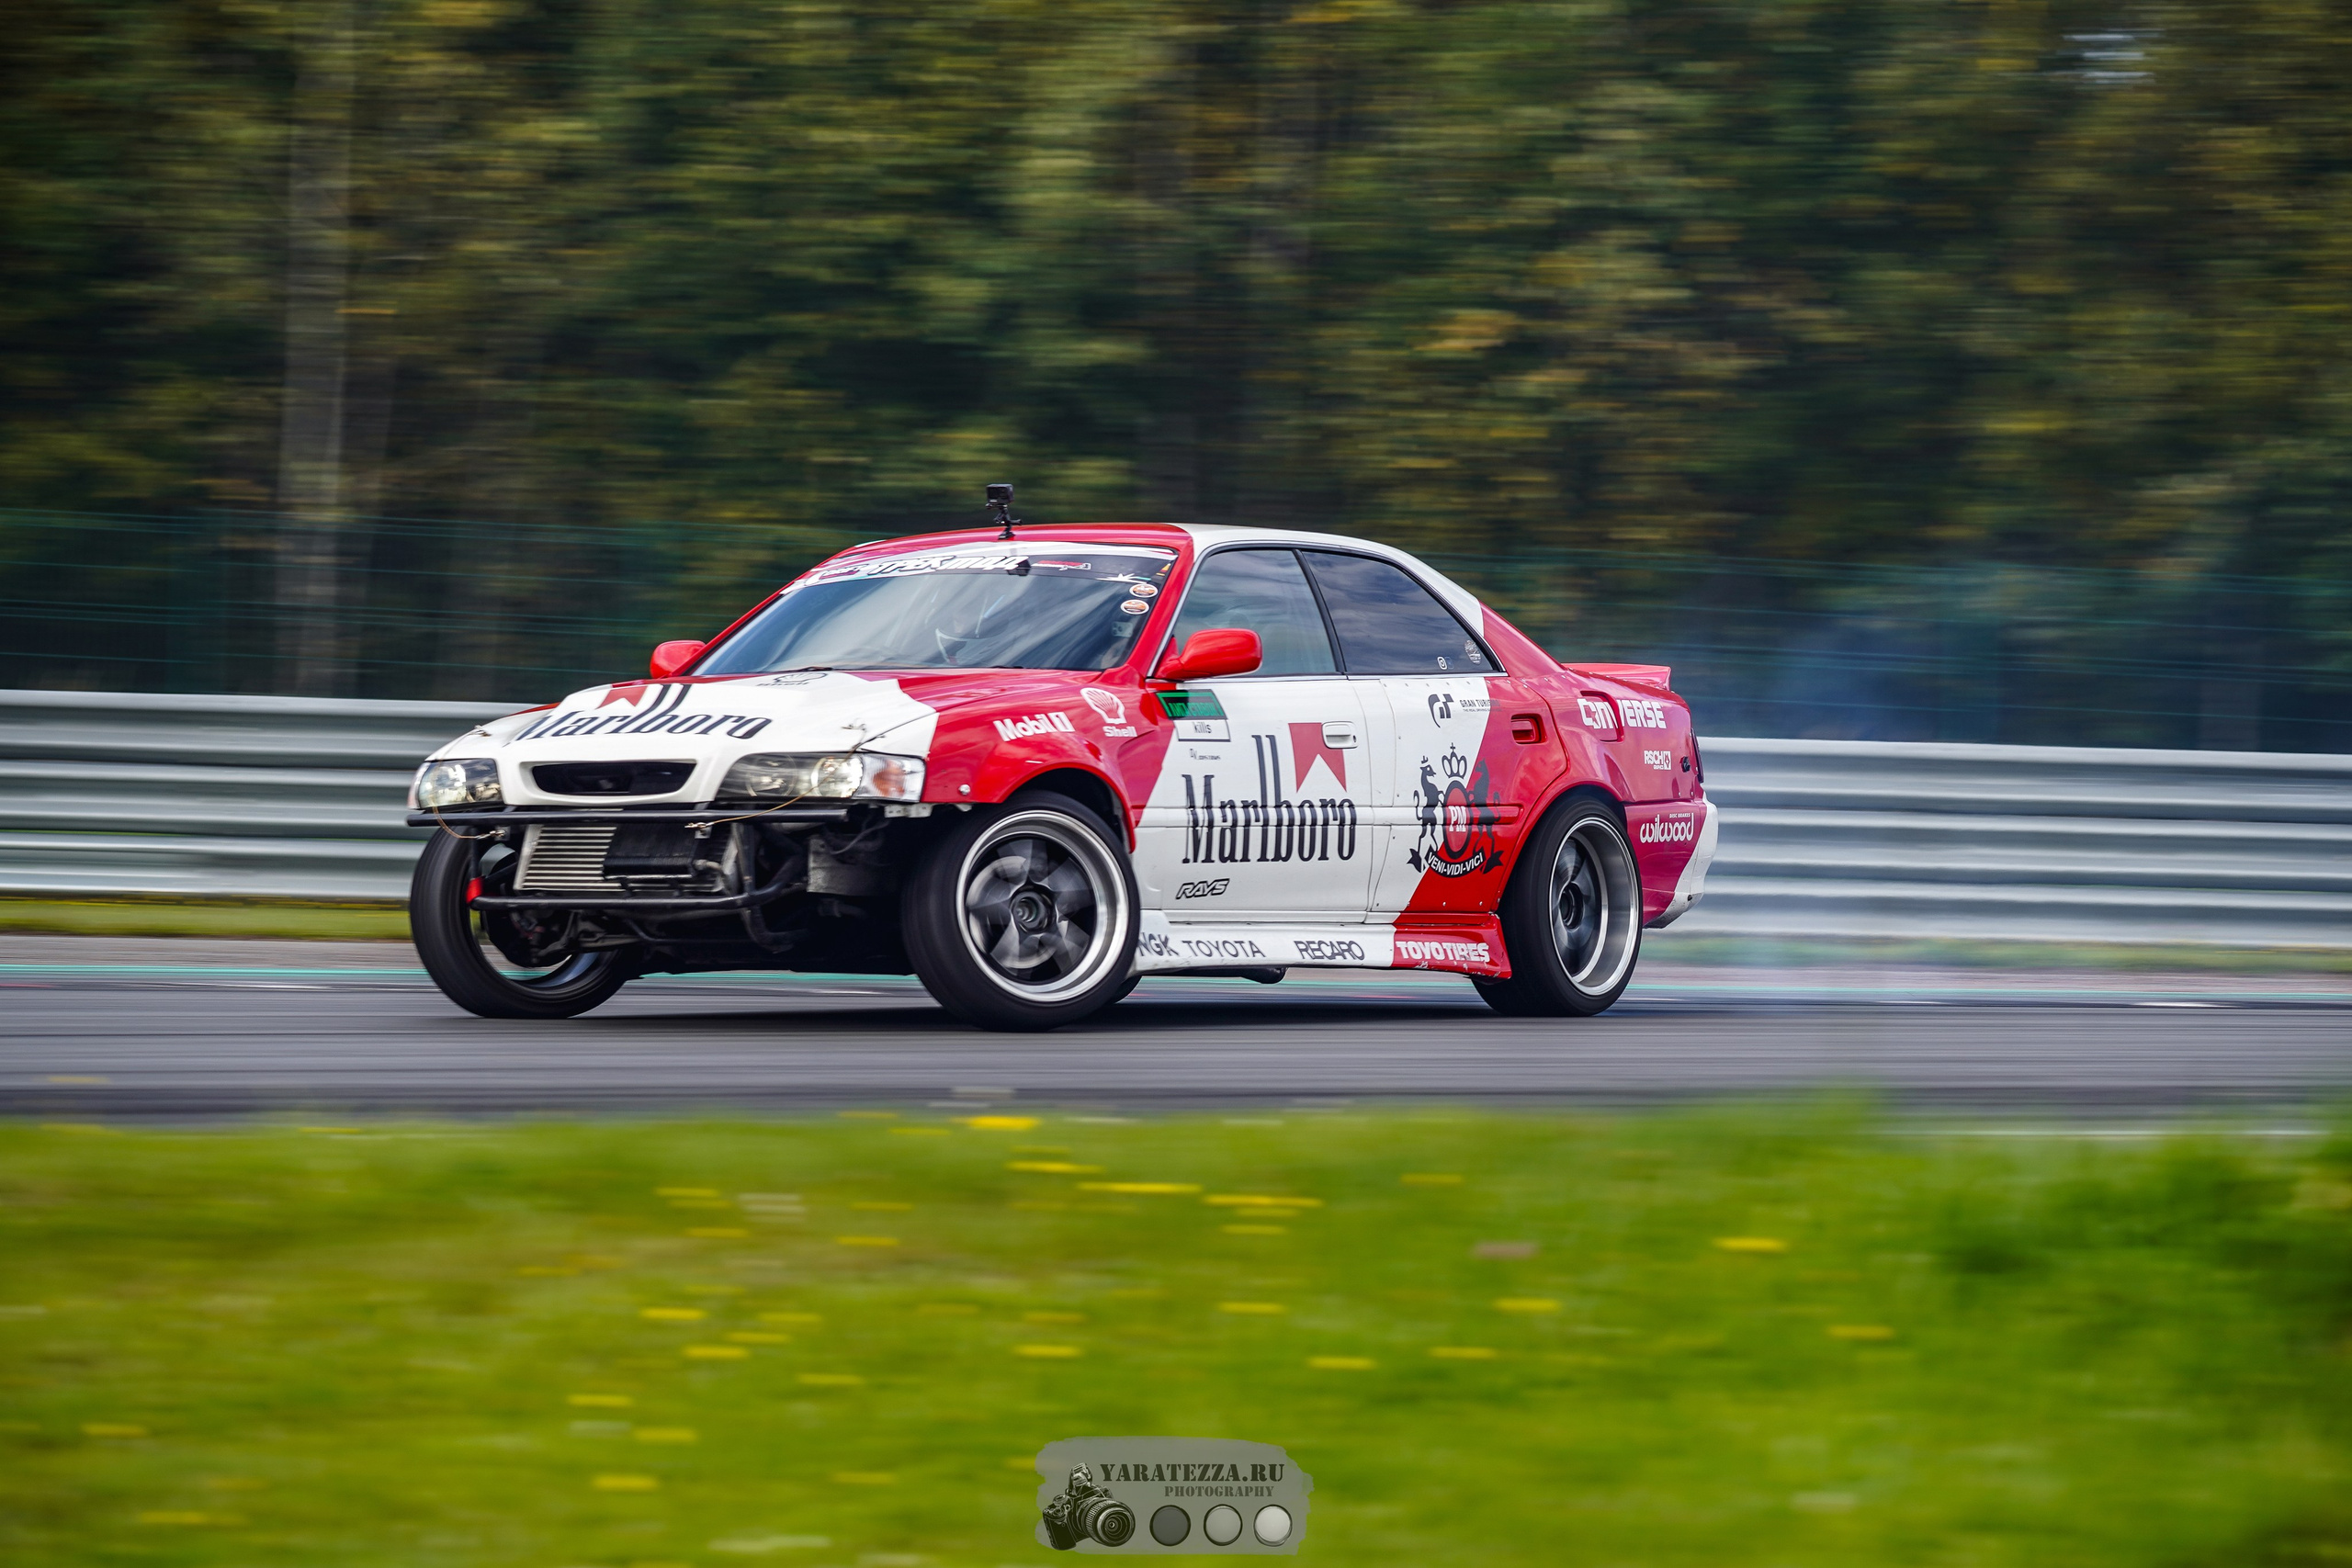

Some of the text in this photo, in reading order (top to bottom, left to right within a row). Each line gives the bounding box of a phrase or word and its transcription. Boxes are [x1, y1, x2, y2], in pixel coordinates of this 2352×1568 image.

[514, 683, 773, 739] Marlboro
[1459, 699, 1476, 708] GRAN
[993, 714, 1057, 741] Mobil
[1102, 726, 1137, 737] Shell
[1182, 735, 1357, 863] Marlboro
[1448, 806, 1467, 832] PM
[1640, 812, 1694, 843] wilwood
[1428, 852, 1484, 875] VENI-VIDI-VICI
[1176, 878, 1230, 899] RAYS
[1137, 931, 1180, 957] NGK
[1182, 940, 1266, 958] TOYOTA
[1294, 940, 1365, 960] RECARO
